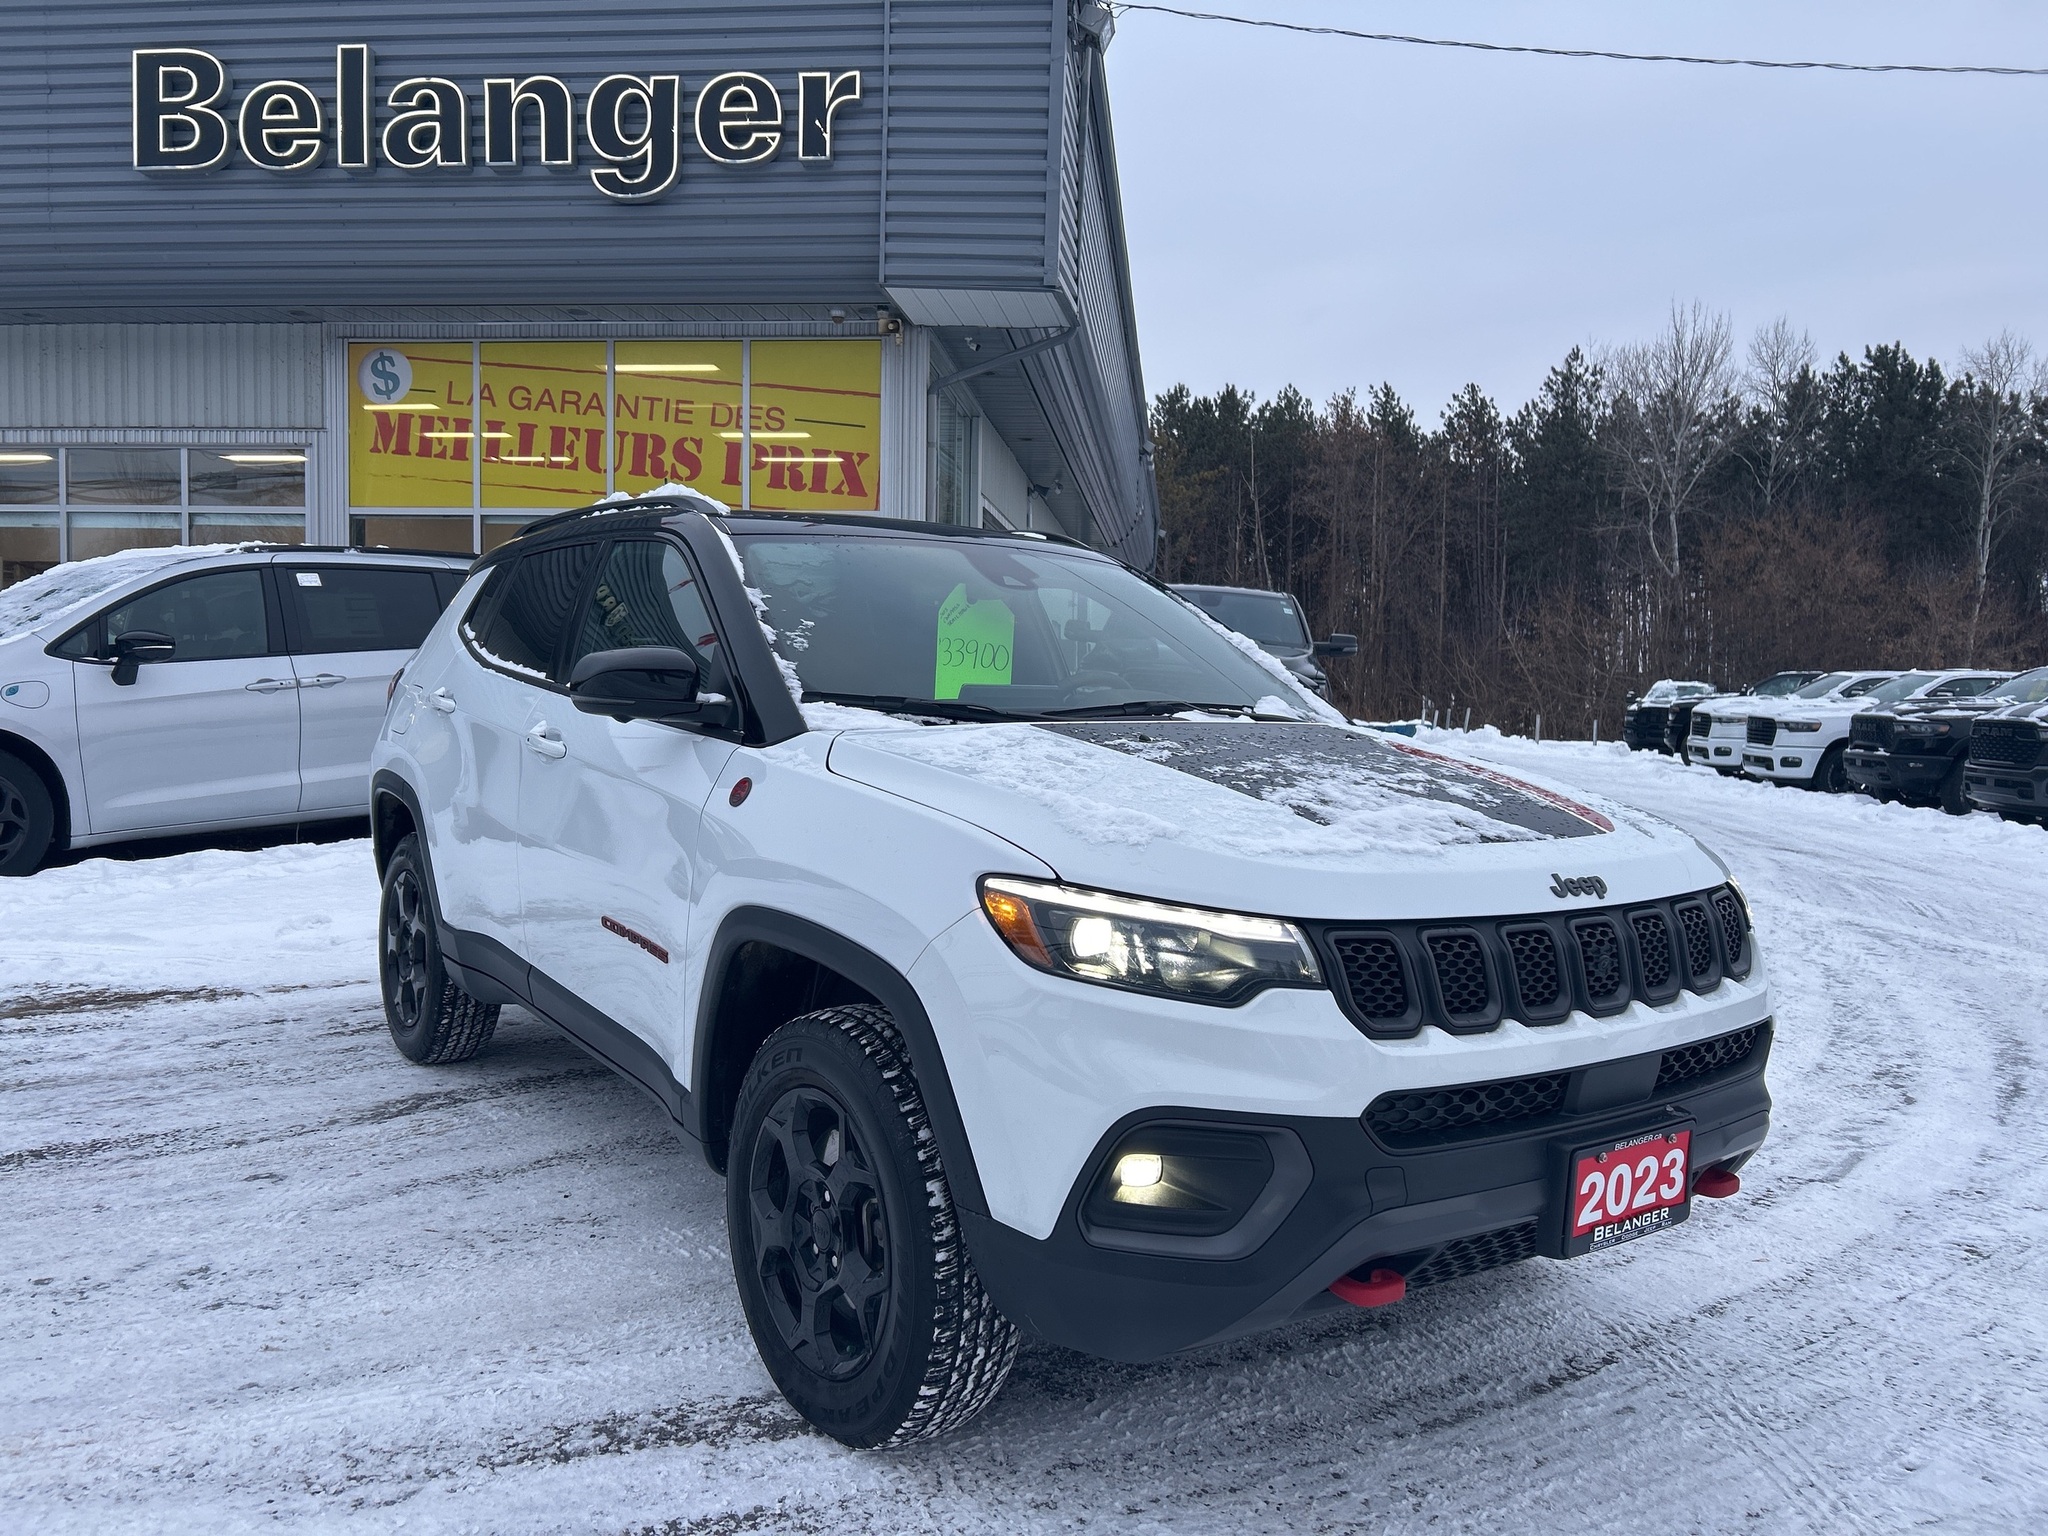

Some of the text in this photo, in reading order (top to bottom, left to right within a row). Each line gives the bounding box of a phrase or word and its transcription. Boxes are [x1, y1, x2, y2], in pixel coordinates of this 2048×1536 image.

[131, 43, 861, 200] Belanger
[446, 381, 786, 432] LA GARANTIE DES
[369, 411, 870, 498] MEILLEURS PRIX
[1856, 722, 1876, 731] RAM
[1981, 727, 2013, 737] RAM
[1549, 873, 1608, 900] Jeep
[601, 915, 669, 964] COMPASS
[1614, 1133, 1662, 1151] BELANGER.ca
[1577, 1148, 1685, 1227] 2023
[1593, 1207, 1669, 1242] BELANGER
